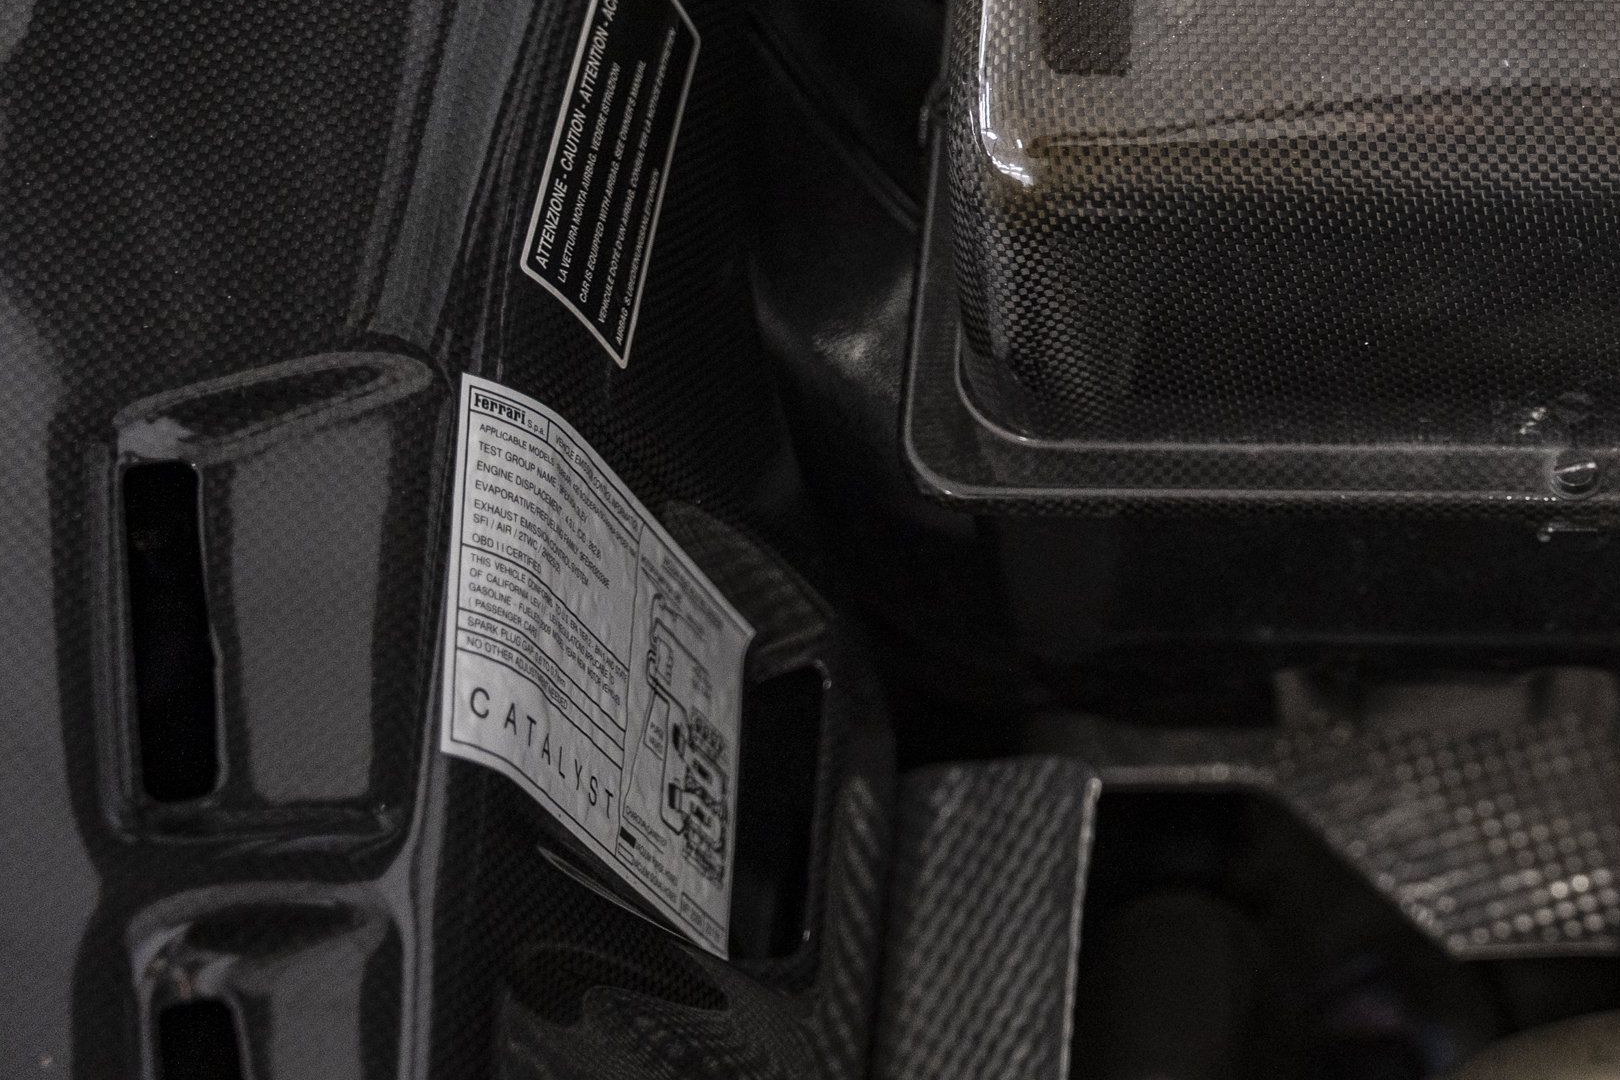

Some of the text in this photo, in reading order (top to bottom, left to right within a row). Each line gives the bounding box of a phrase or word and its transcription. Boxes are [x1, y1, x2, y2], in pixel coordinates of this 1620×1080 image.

[602, 63, 620, 114] ISTRUZIONI
[536, 179, 567, 268] ATTENZIONE
[561, 109, 585, 171] CAUTION
[580, 26, 608, 102] ATTENTION
[592, 113, 607, 151] VEDERE
[579, 280, 590, 303] CAR
[587, 222, 604, 271] EQUIPPED
[599, 196, 610, 222] WITH
[615, 139, 625, 160] SEE
[630, 61, 646, 98] MANUAL
[573, 190, 587, 225] MONTA
[562, 225, 578, 268] VETTURA
[558, 269, 568, 283] LA
[598, 276, 614, 323] VEHICULE
[475, 393, 525, 424] Ferrari
[480, 424, 527, 450] APPLICABLE
[556, 437, 574, 460] VEHICLE
[479, 441, 502, 457] TEST
[505, 452, 536, 472] GROUP
[537, 467, 556, 488] NAME
[477, 460, 513, 482] ENGINE
[516, 476, 562, 516] DISPLACEMENT
[473, 513, 489, 526] SFI
[496, 522, 512, 535] AIR
[474, 499, 518, 522] EXHAUST
[520, 517, 550, 546] EMISSION
[471, 553, 491, 568] THIS
[495, 563, 526, 584] VEHICLE
[472, 533, 494, 548] OBD
[506, 546, 542, 574] CERTIFIED
[469, 583, 511, 606] GASOLINE
[470, 568, 483, 578] OF
[487, 574, 529, 600] CALIFORNIA
[475, 599, 522, 626] PASSENGER
[467, 636, 483, 649] NO
[485, 642, 513, 662] OTHER
[468, 616, 498, 635] SPARK
[501, 628, 522, 647] PLUG
[471, 688, 614, 821] CATALYST
